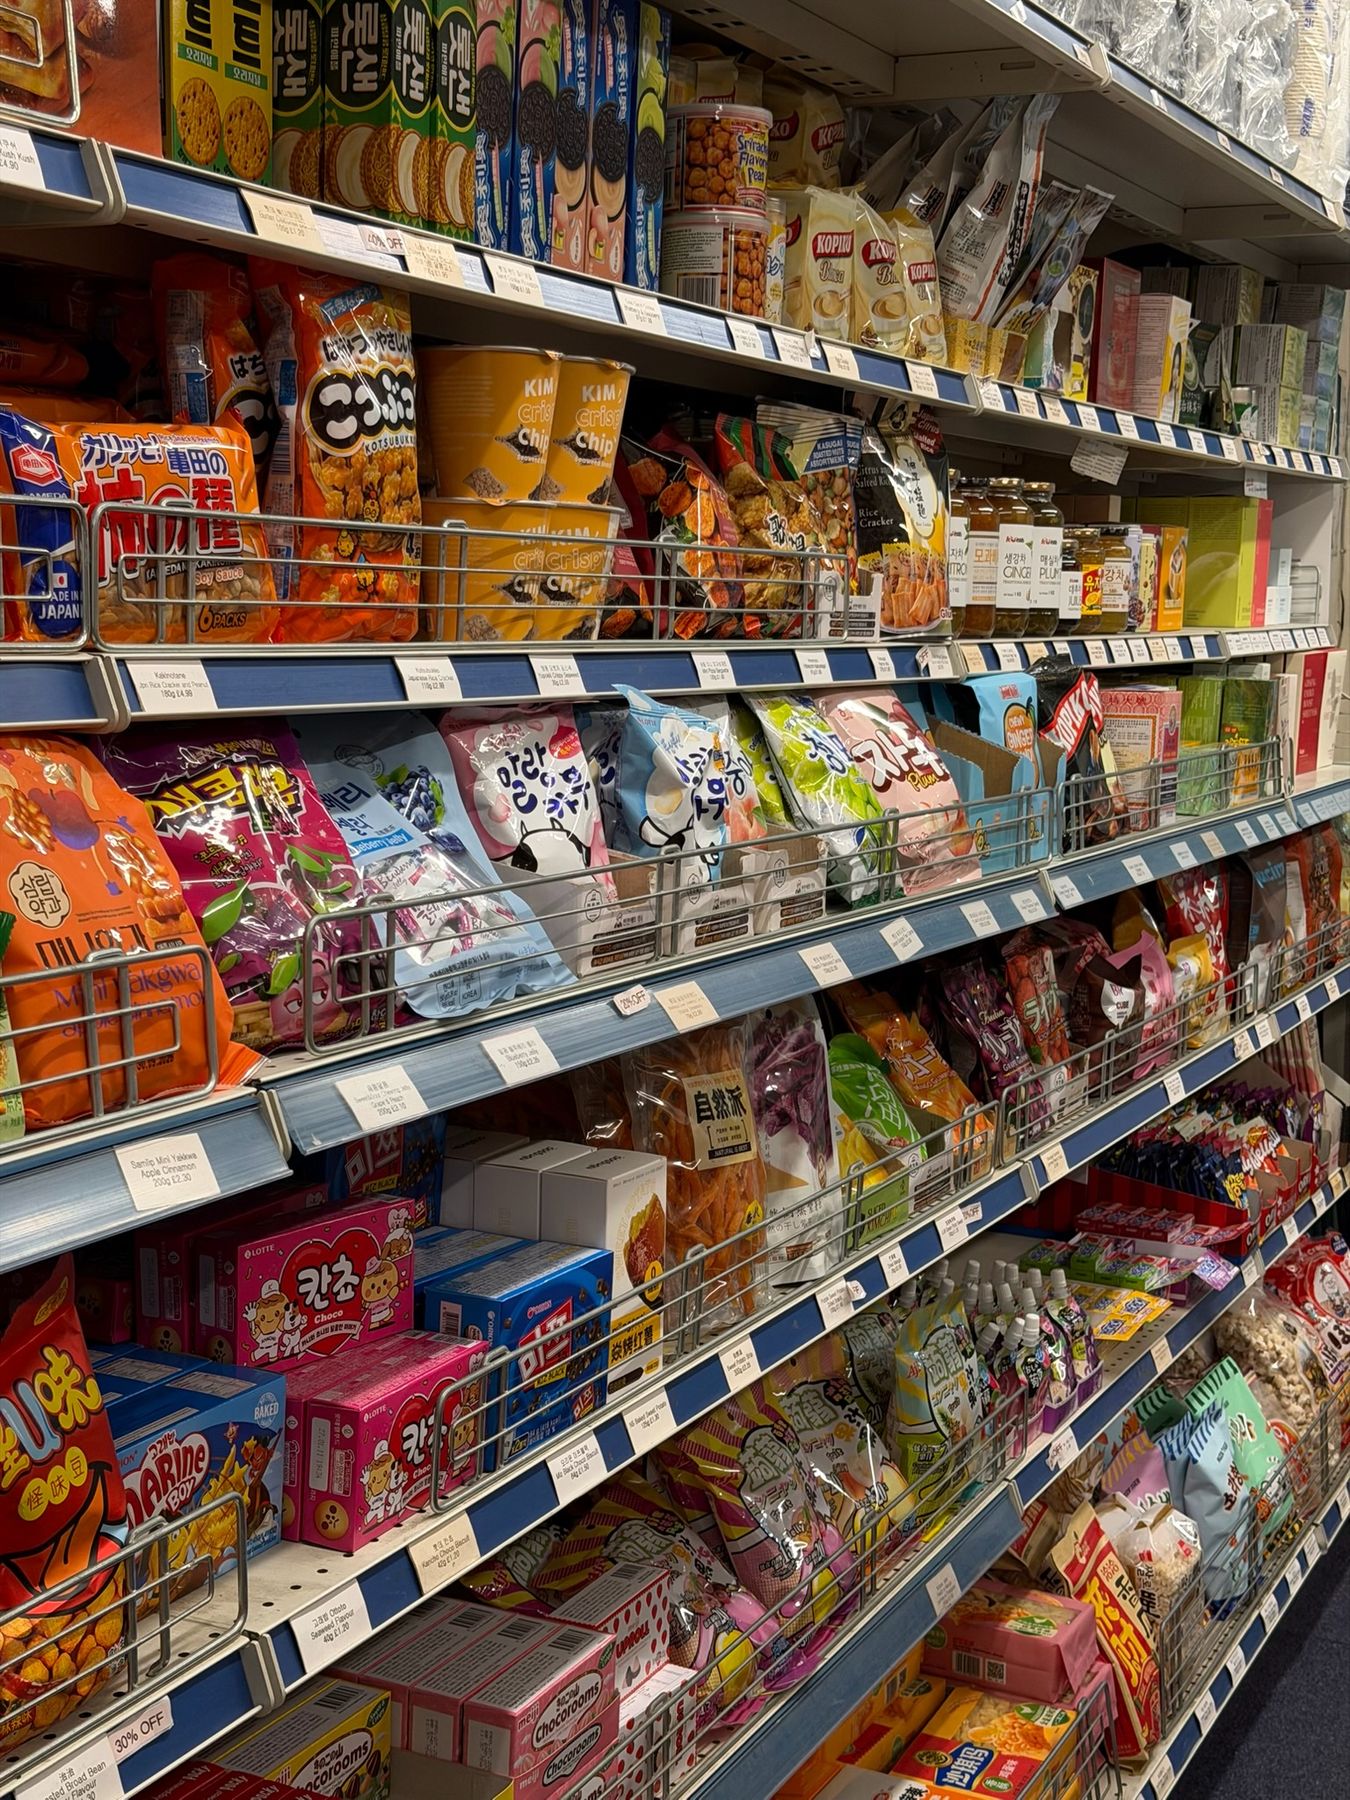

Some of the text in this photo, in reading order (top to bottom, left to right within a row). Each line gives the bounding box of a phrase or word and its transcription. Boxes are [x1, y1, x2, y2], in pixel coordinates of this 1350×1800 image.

[340, 2, 379, 93] 롯샌
[402, 5, 426, 102] 롯샌
[450, 22, 471, 116] 롯샌
[748, 167, 765, 185] Peas
[388, 237, 403, 250] OFF
[816, 233, 852, 254] KOPIKO
[319, 373, 415, 440] こつぶっ
[817, 439, 843, 450] KASUGAI
[810, 455, 845, 468] ASSORTMENT
[859, 508, 878, 518] Rice
[859, 517, 894, 528] Cracker
[1004, 553, 1026, 565] 생강차
[195, 571, 213, 584] Soy
[215, 568, 244, 581] Sauce
[1105, 569, 1124, 581] 강차
[39, 604, 80, 620] JAPAN
[161, 690, 193, 699] 180g £4.99
[907, 773, 938, 792] Plum
[19, 872, 54, 898] 삼립
[29, 898, 62, 919] 약과
[55, 978, 108, 1010] Mni
[631, 990, 647, 1004] OFF
[694, 1085, 746, 1124] 自然派
[130, 1152, 198, 1169] Samlip Mini Yakkwa
[141, 1163, 196, 1179] Apple Cinnamon
[154, 1173, 191, 1188] 200g £2.30
[251, 1244, 275, 1257] LOTTE
[297, 1254, 359, 1310] 칸쵸
[314, 1309, 344, 1324] Choco
[255, 1403, 278, 1420] BAKED
[368, 1405, 386, 1418] LOTTE
[413, 1464, 432, 1478] Choc
[563, 1463, 574, 1475] Black
[574, 1455, 586, 1468] Choco
[26, 1454, 85, 1510] 怪味豆
[168, 1478, 195, 1510] BOY
[422, 1535, 470, 1568] Kancho Choco Biscuit
[311, 1609, 354, 1640] Seaweed Flavour
[312, 1603, 347, 1628] 고래밥 Ottoto
[323, 1622, 350, 1643] 40g £1.20
[518, 1681, 600, 1742] meiji Chocorooms
[115, 1711, 165, 1753] 30% OFF
[546, 1729, 600, 1780] Chocorooms
[65, 1761, 107, 1792] Broad Bean
[520, 1770, 539, 1789] meiji
